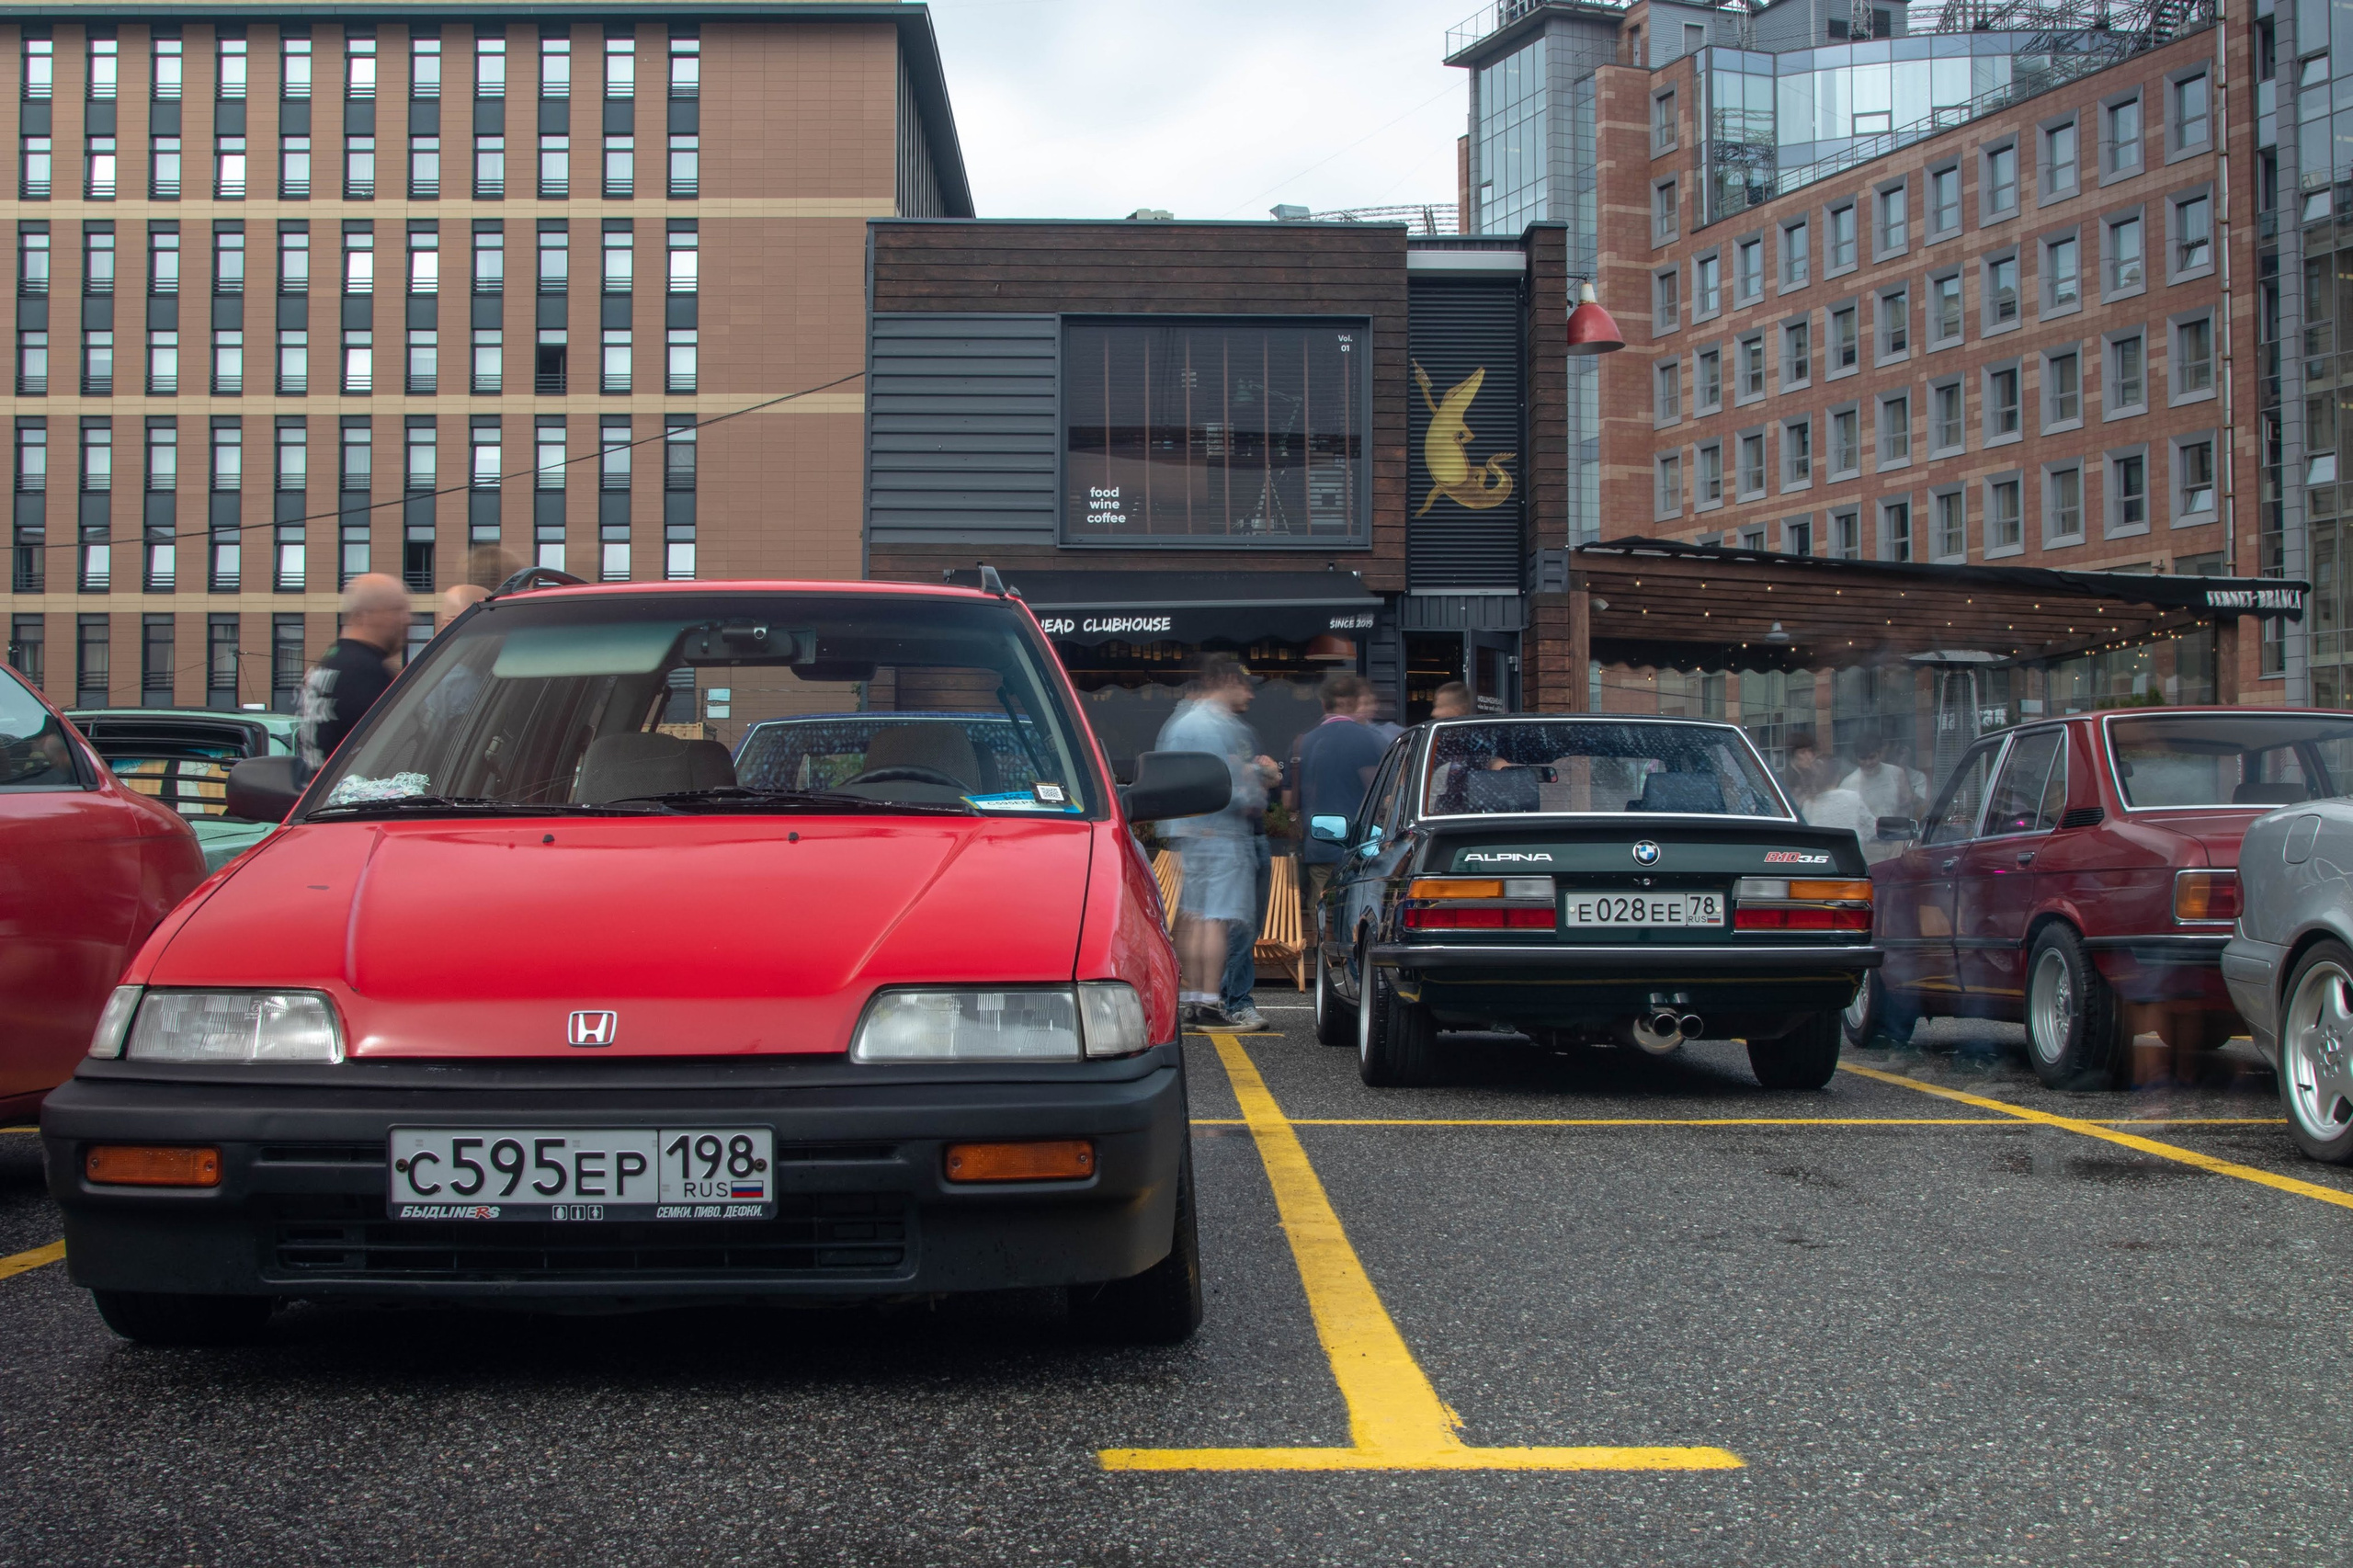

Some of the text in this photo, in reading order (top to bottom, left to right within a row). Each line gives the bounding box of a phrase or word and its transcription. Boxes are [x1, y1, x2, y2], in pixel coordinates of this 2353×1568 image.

[1090, 486, 1120, 497] food
[1089, 498, 1120, 509] wine
[1086, 512, 1126, 523] coffee
[1040, 617, 1171, 634] EAD CLUBHOUSE
[1329, 618, 1374, 629] SINCE 2019
[1464, 853, 1553, 862] ALPINA
[1578, 896, 1715, 922] E028EE 78
[408, 1133, 755, 1197] C595EP 198
[684, 1182, 729, 1198] RUS
[656, 1204, 763, 1219] СЕМКИ. ПИВО. ДЕФКИ.
